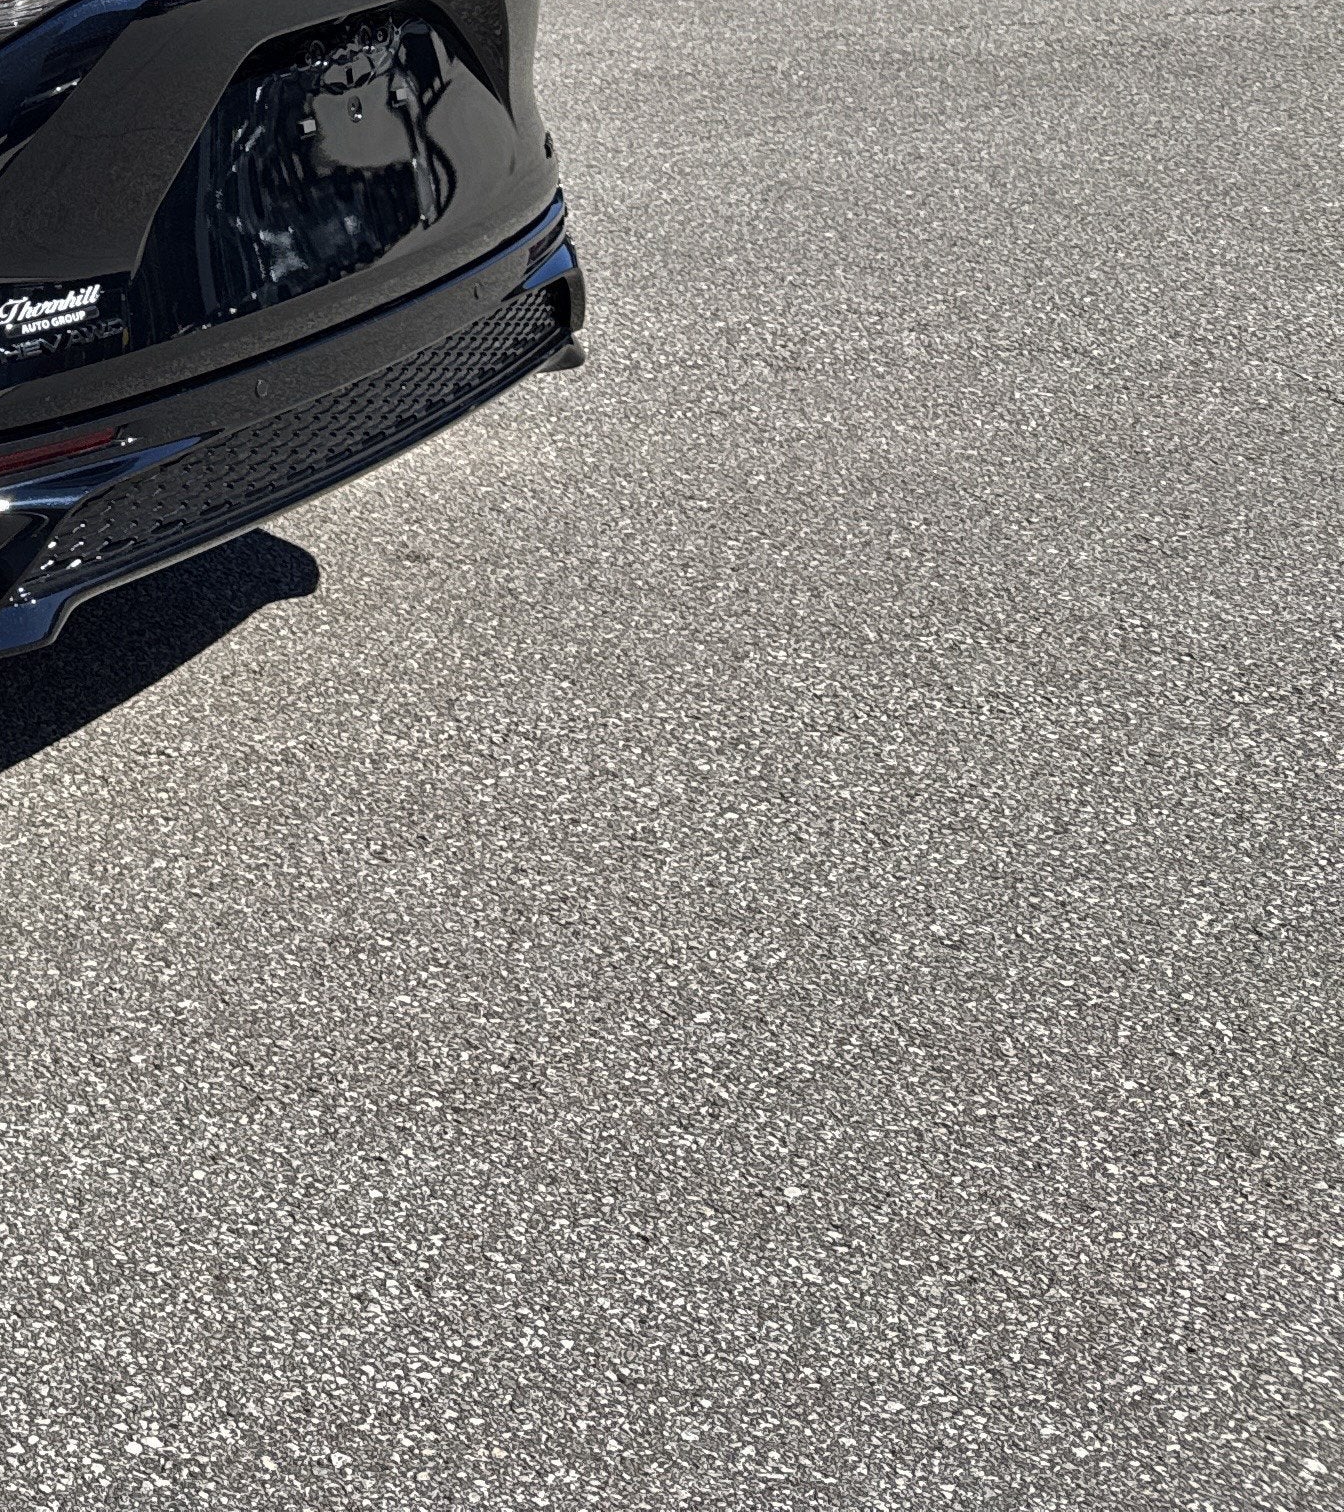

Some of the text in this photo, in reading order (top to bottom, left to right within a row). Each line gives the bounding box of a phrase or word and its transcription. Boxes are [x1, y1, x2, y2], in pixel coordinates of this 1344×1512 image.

[21, 310, 86, 335] AUTO GROUP
[65, 317, 124, 351] AWD
